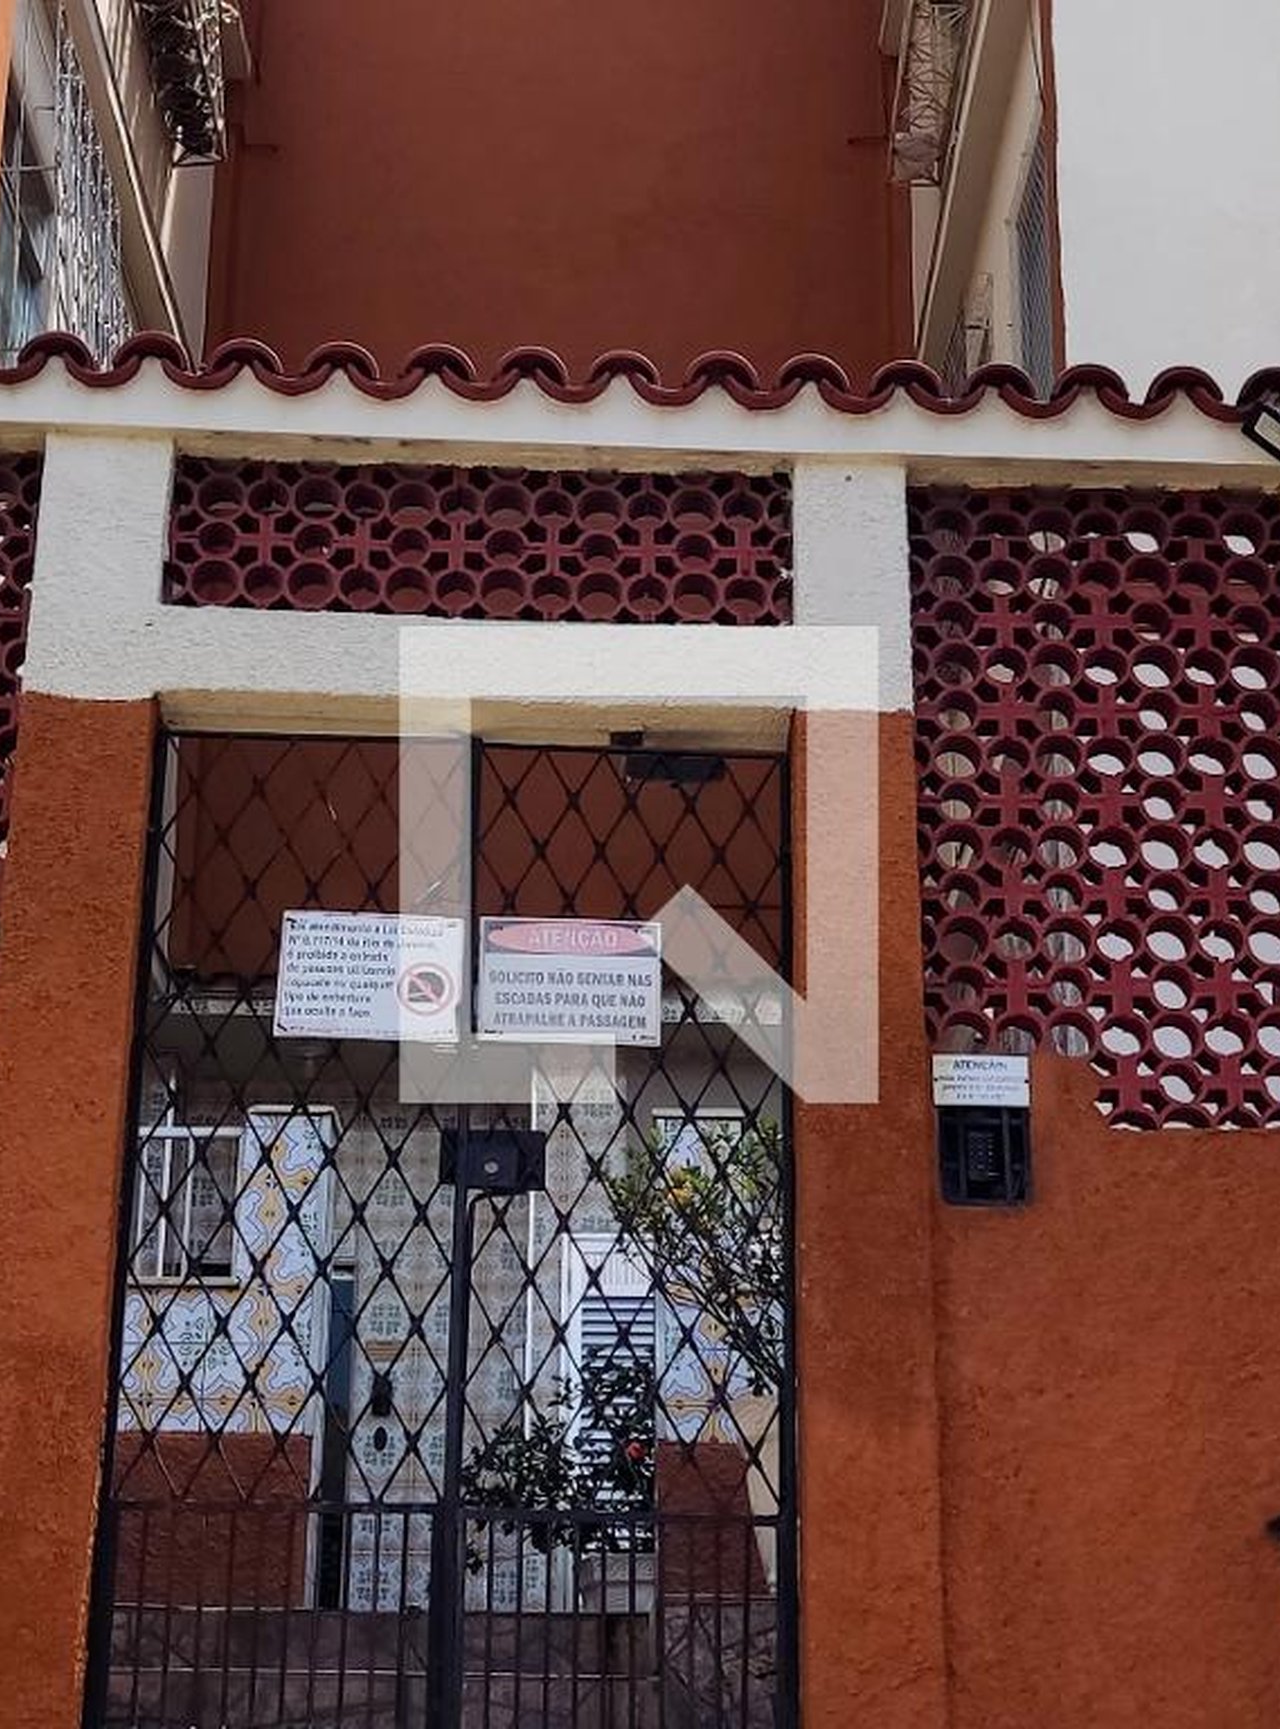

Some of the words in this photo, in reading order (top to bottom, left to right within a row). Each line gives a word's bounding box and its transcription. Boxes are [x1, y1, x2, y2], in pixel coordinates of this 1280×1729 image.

[528, 926, 619, 949] ATENÇÃO
[488, 970, 545, 986] SOLICITO
[547, 968, 574, 987] NÃO
[577, 971, 624, 987] SENTAR
[627, 973, 653, 988] NAS
[495, 990, 552, 1006] ESCADAS
[554, 992, 589, 1007] PARA
[591, 993, 617, 1009] QUE
[620, 992, 646, 1008] NÃO
[492, 1011, 566, 1027] ATRAPALHE
[568, 1013, 577, 1027] A
[580, 1013, 648, 1030] PASSAGEM
